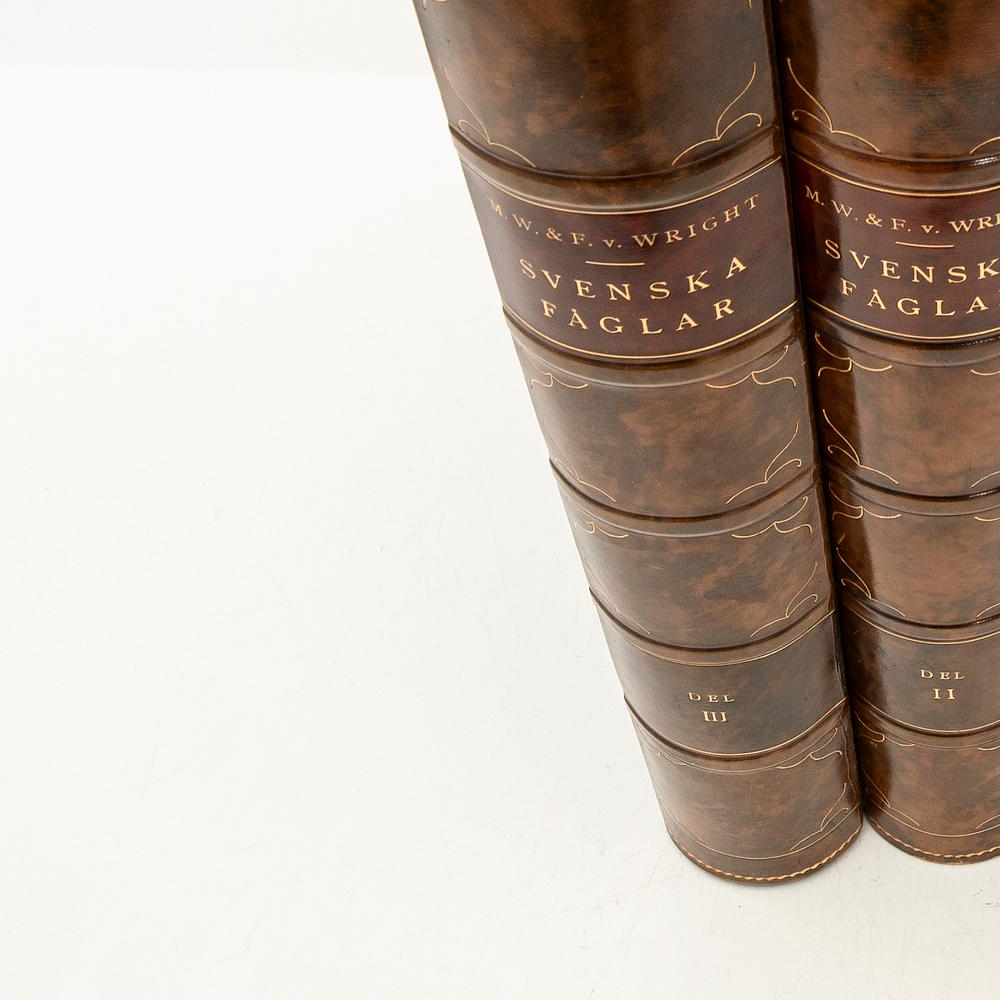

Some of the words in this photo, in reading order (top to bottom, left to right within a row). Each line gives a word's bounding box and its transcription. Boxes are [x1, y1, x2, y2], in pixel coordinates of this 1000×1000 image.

[490, 199, 507, 219] M.
[512, 213, 539, 235] W.
[546, 227, 563, 242] &
[571, 232, 593, 247] F.
[602, 239, 622, 248] v.
[632, 193, 760, 248] WRIGHT
[805, 185, 825, 206] M.
[832, 200, 858, 221] W.
[865, 213, 883, 227] &
[891, 218, 911, 232] F.
[921, 224, 940, 234] v.
[519, 256, 747, 301] SVENSKA
[541, 299, 735, 335] FÅGLAR
[920, 669, 966, 680] DEL
[688, 692, 735, 703] DEL
[933, 688, 956, 700] II
[702, 711, 727, 722] III
